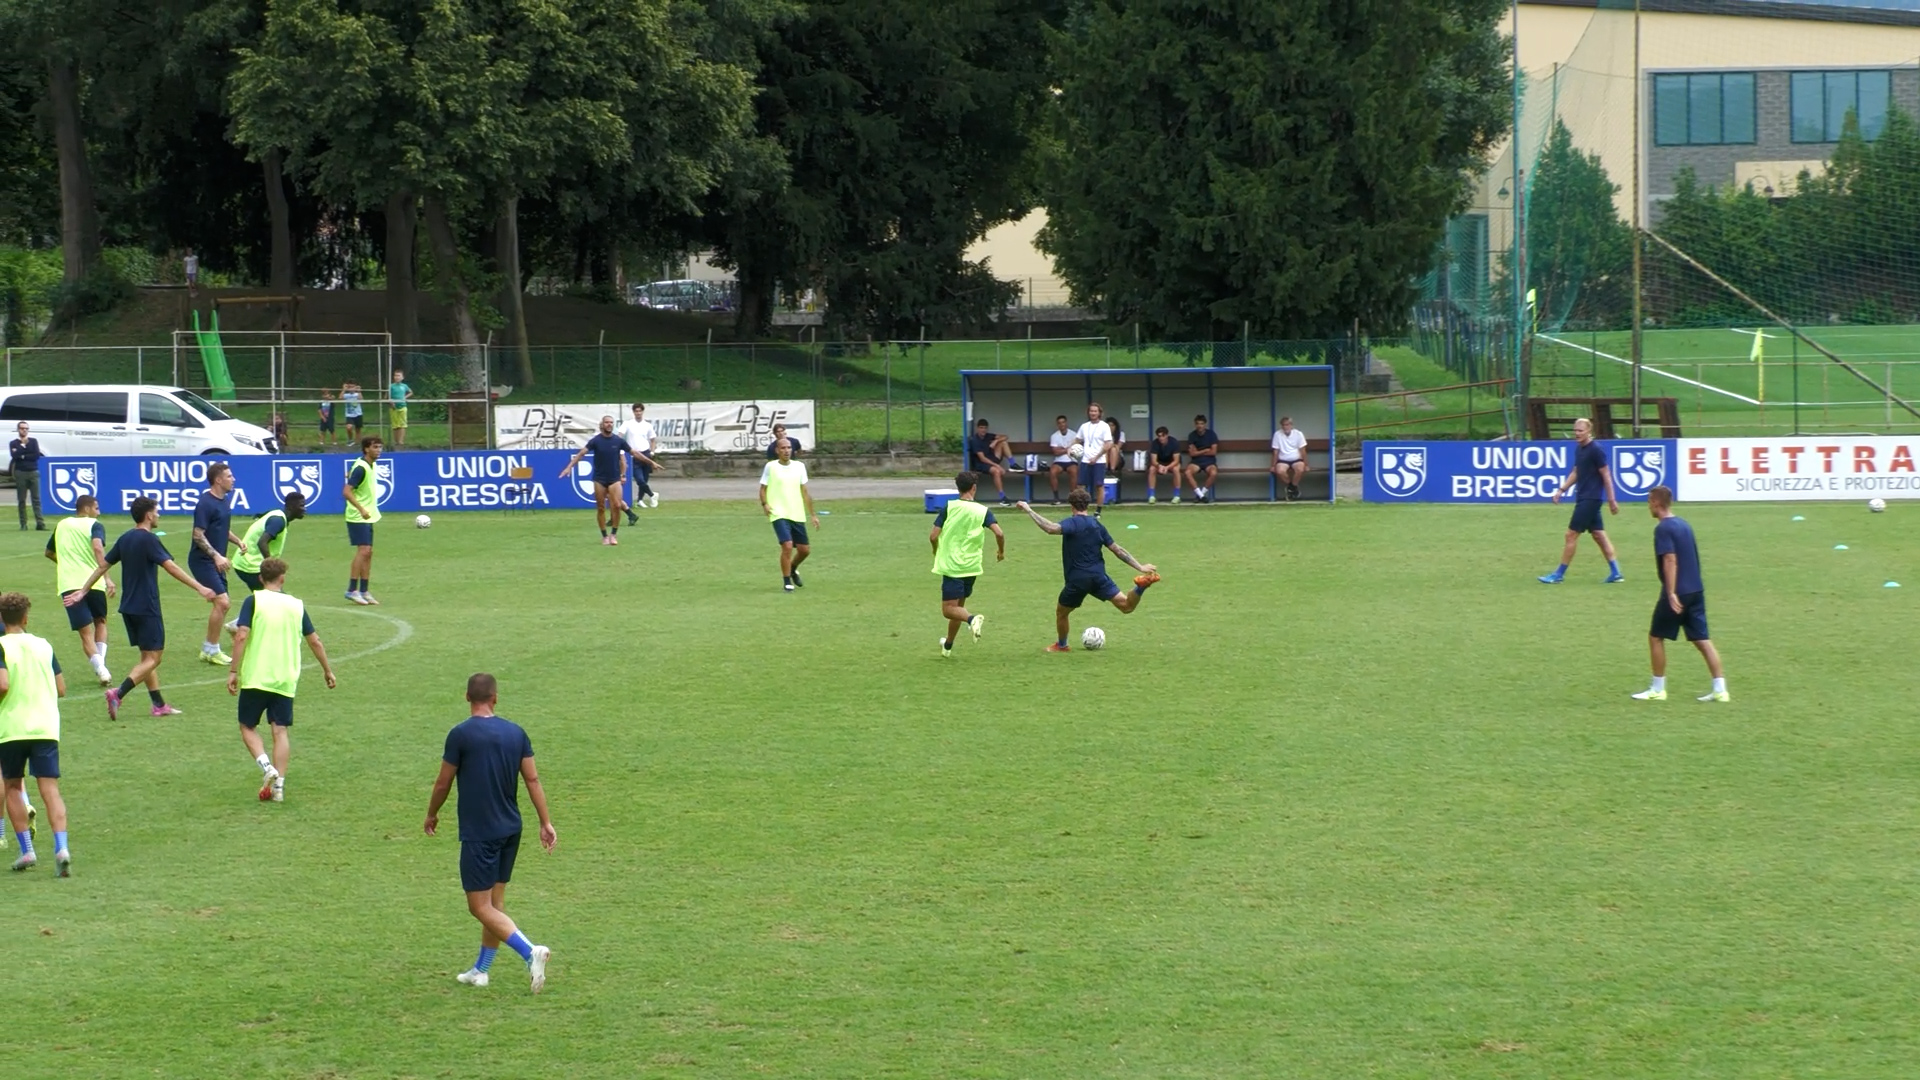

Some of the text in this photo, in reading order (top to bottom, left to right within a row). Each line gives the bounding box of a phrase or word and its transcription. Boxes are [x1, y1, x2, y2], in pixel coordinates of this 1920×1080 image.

[733, 432, 774, 448] dibief
[437, 455, 527, 479] UNION
[1472, 446, 1567, 470] UNION
[1688, 445, 1916, 475] ELETTRA
[140, 460, 228, 483] UNIO
[418, 482, 549, 507] BRESCIA
[1736, 477, 1822, 492] SICUREZZA
[1829, 477, 1839, 490] E
[121, 488, 250, 511] BRESA
